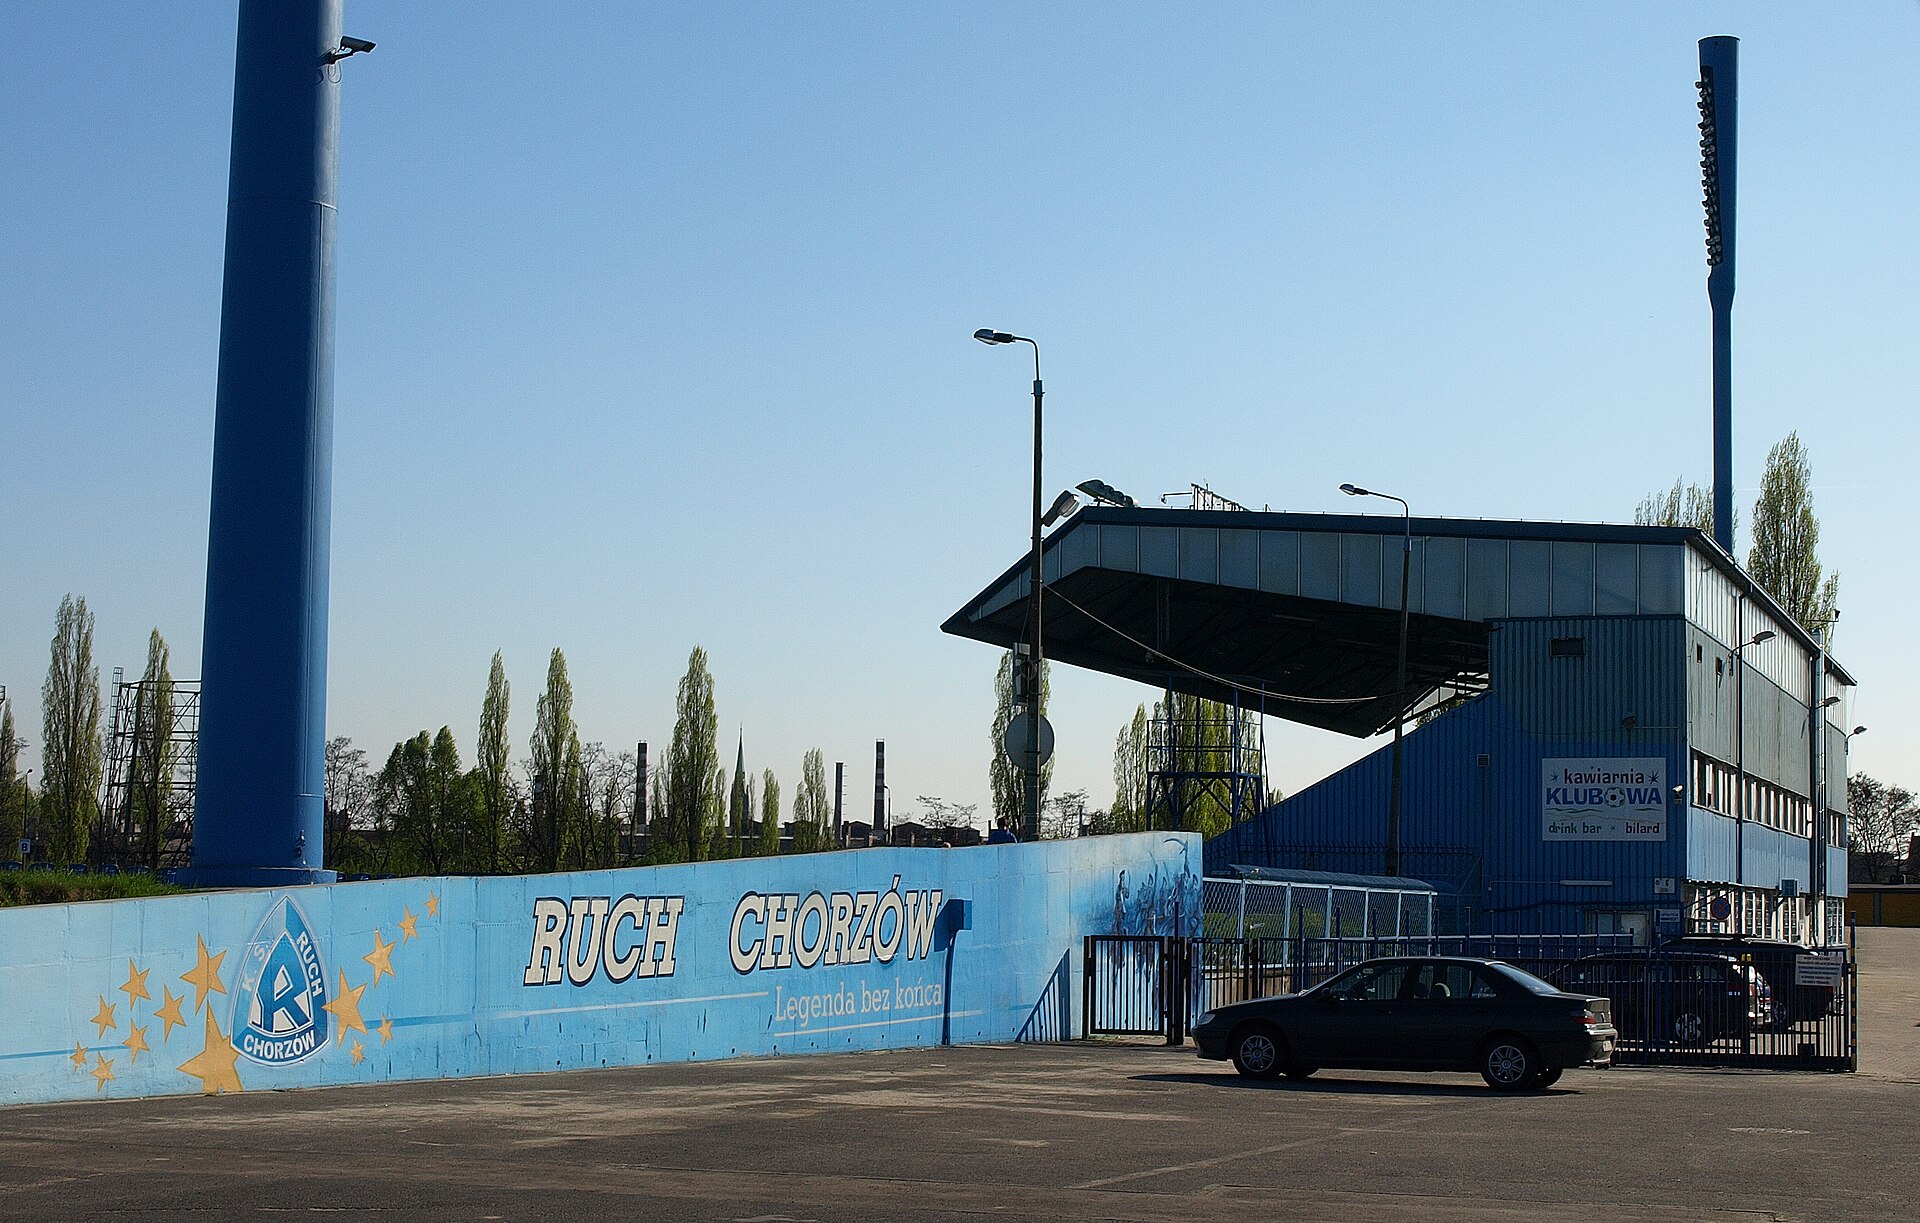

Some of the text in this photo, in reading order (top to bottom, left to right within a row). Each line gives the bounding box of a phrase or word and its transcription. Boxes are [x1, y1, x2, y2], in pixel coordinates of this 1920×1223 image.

[1564, 768, 1645, 784] kawiarnia
[1549, 822, 1602, 834] drink bar
[1626, 822, 1660, 834] bilard
[523, 874, 944, 986] RUCH CHORZÓW
[297, 931, 323, 997] RUCH
[775, 976, 943, 1028] Legenda bez końca
[243, 1030, 315, 1059] CHORZÓW
